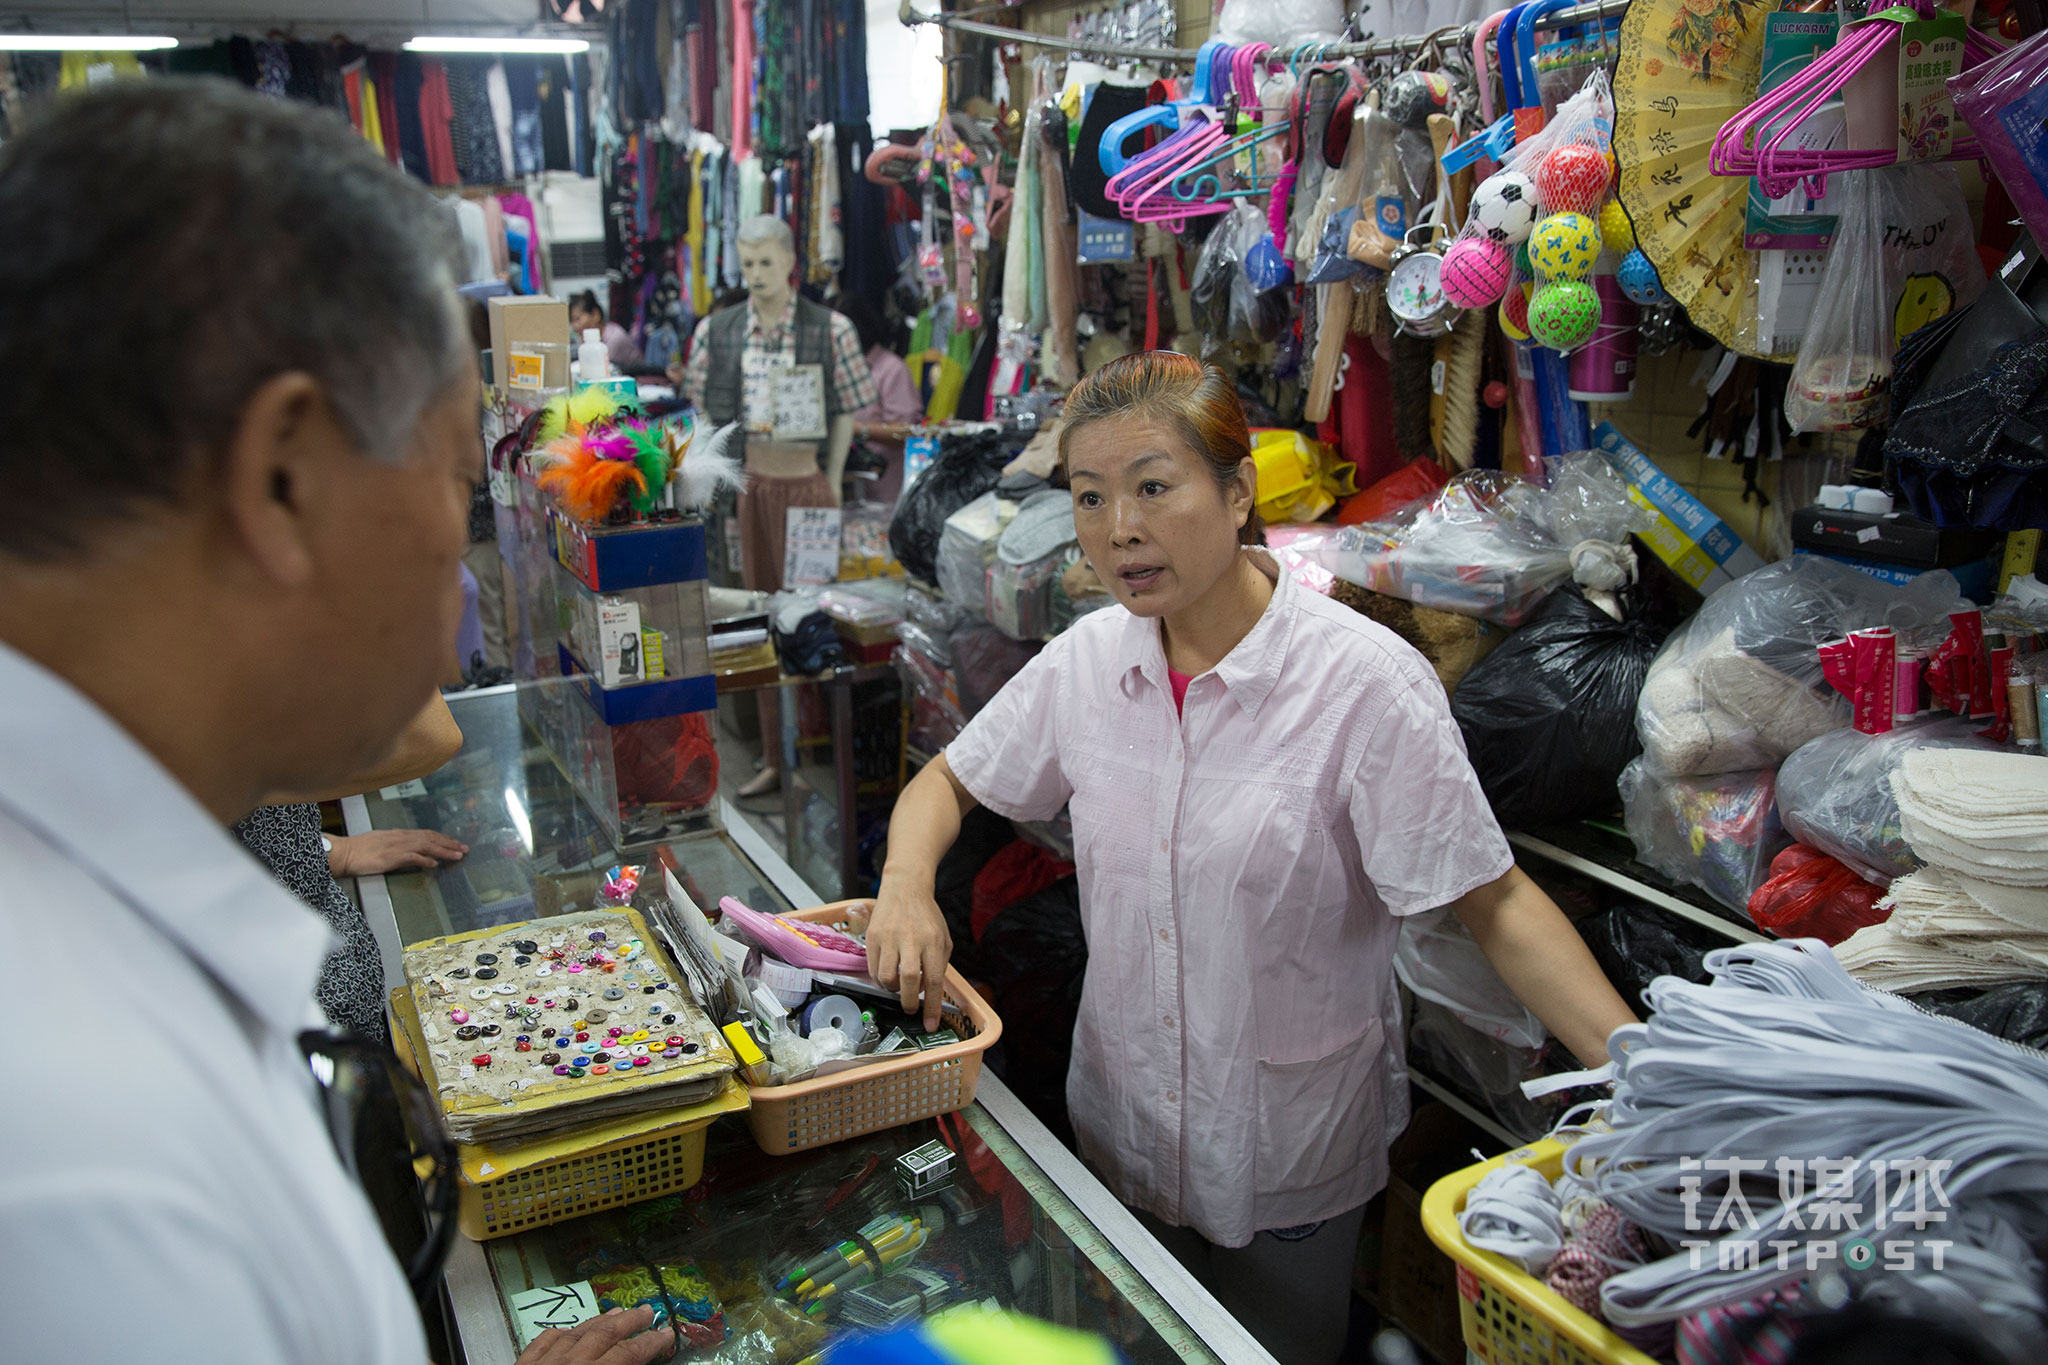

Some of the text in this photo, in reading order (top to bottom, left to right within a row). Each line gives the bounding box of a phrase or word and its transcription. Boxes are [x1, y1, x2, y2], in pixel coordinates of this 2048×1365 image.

[1773, 23, 1830, 34] LUCKARM
[1905, 60, 1953, 80] 高级晾衣架
[1064, 1222, 1080, 1235] 13
[1083, 1242, 1100, 1256] 14
[1104, 1266, 1122, 1278] 15
[1127, 1288, 1145, 1302] 16
[1149, 1313, 1169, 1326] 17
[1173, 1339, 1192, 1354] 18
